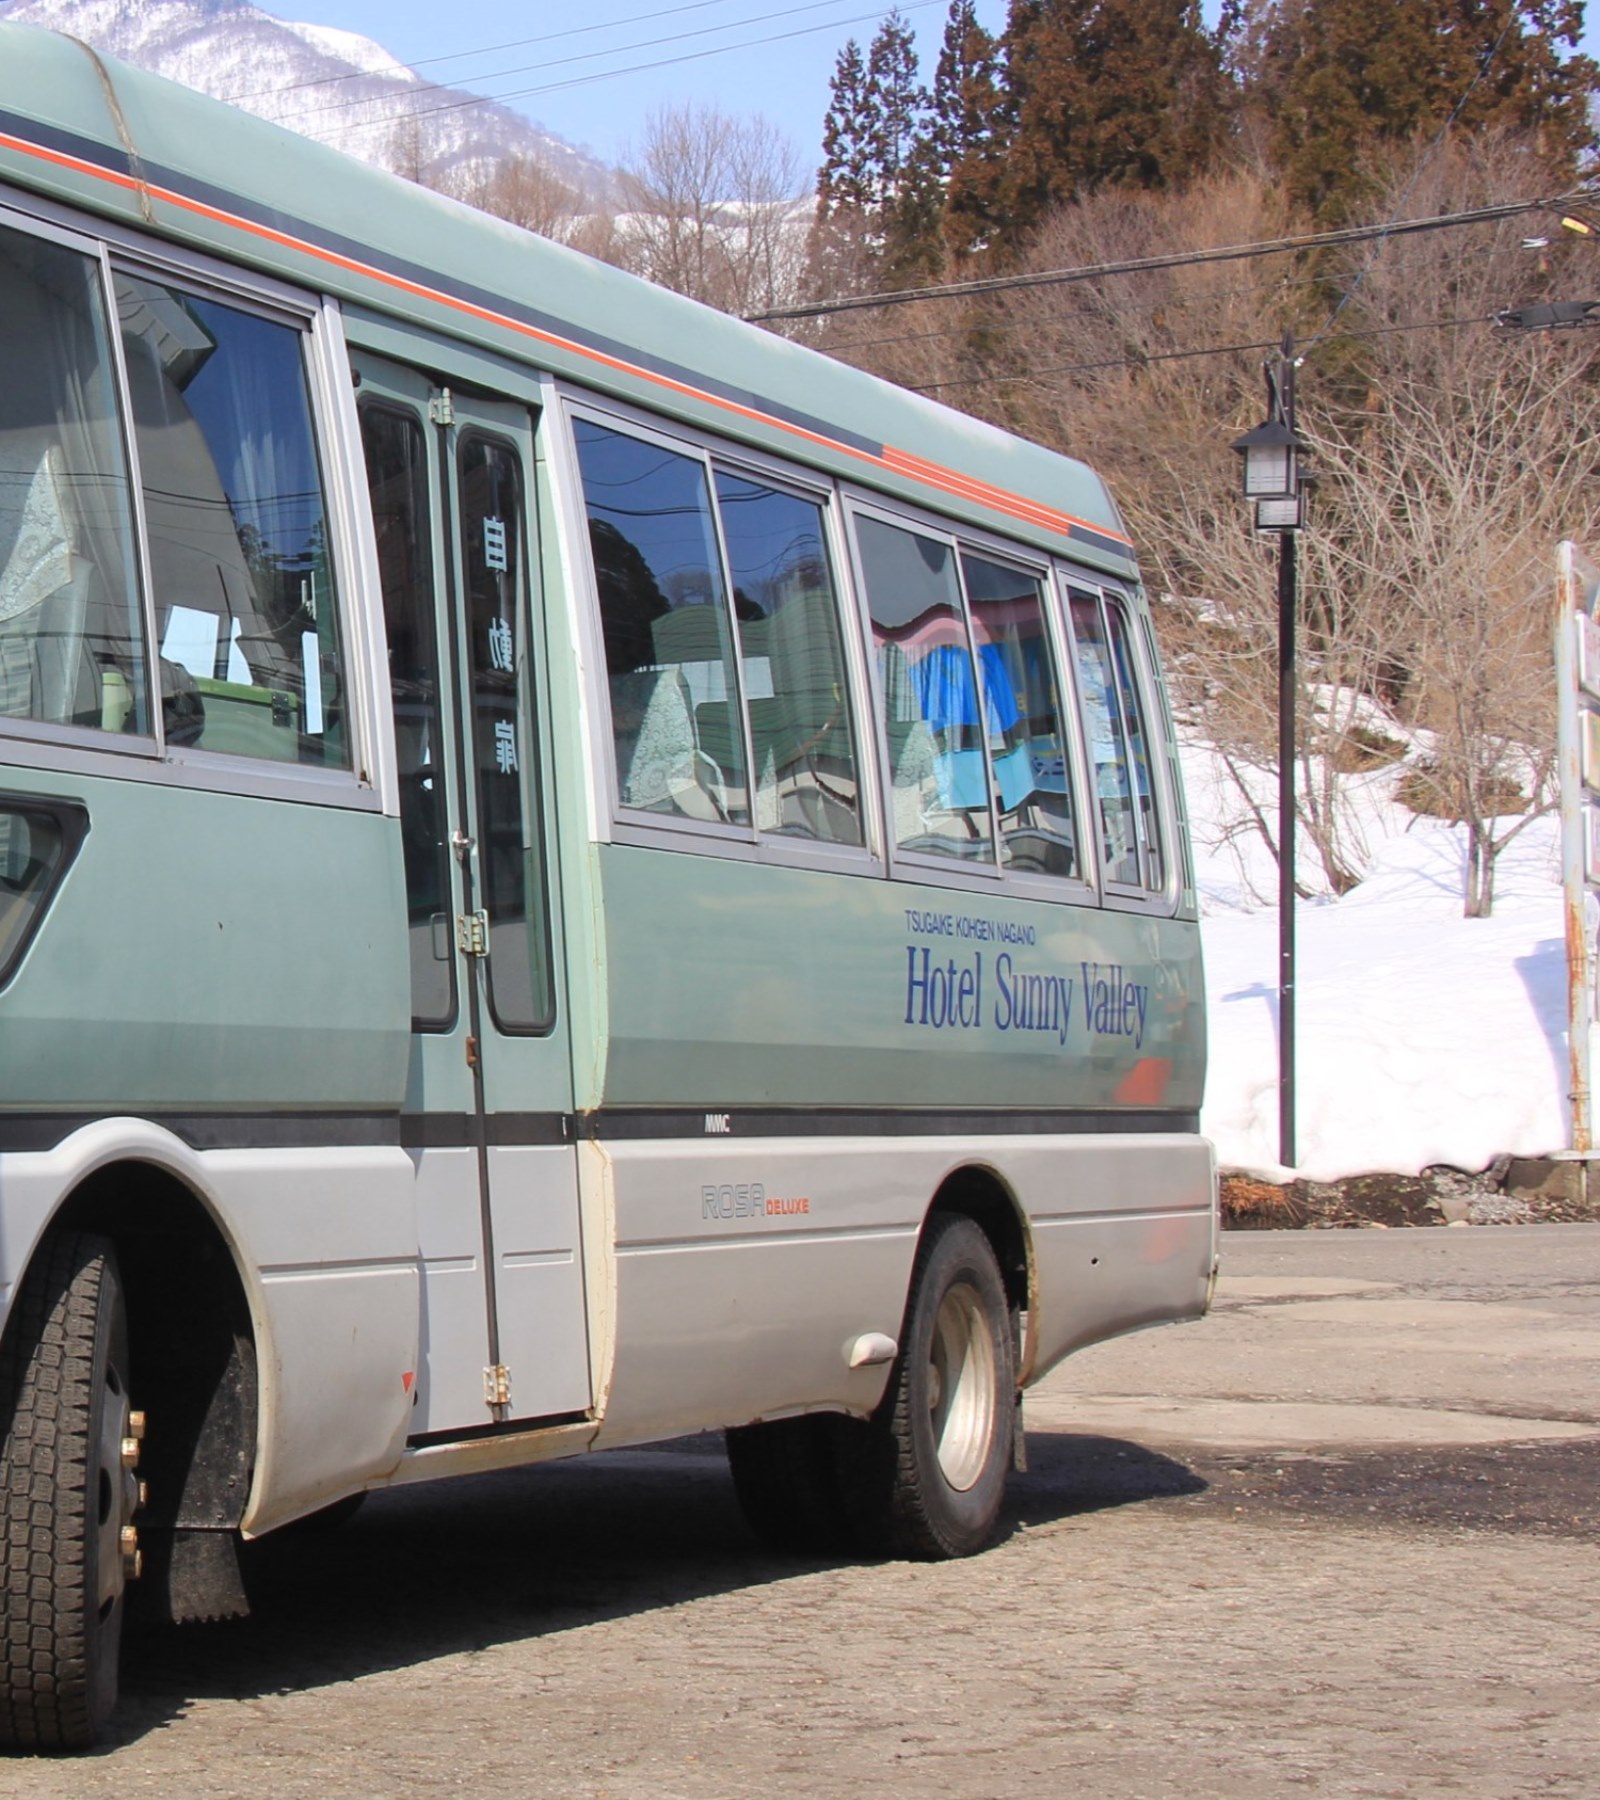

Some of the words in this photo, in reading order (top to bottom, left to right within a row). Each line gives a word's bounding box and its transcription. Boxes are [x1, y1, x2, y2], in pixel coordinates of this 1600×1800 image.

[905, 909, 953, 936] TSUGAIKE
[956, 913, 994, 942] KOHGEN
[997, 922, 1036, 946] NAGANO
[904, 946, 982, 1028] Hotel
[994, 952, 1073, 1046] Sunny
[1081, 961, 1148, 1049] Valley
[704, 1114, 730, 1133] MMC
[701, 1183, 765, 1219] ROSA
[766, 1198, 809, 1215] DELUXE
